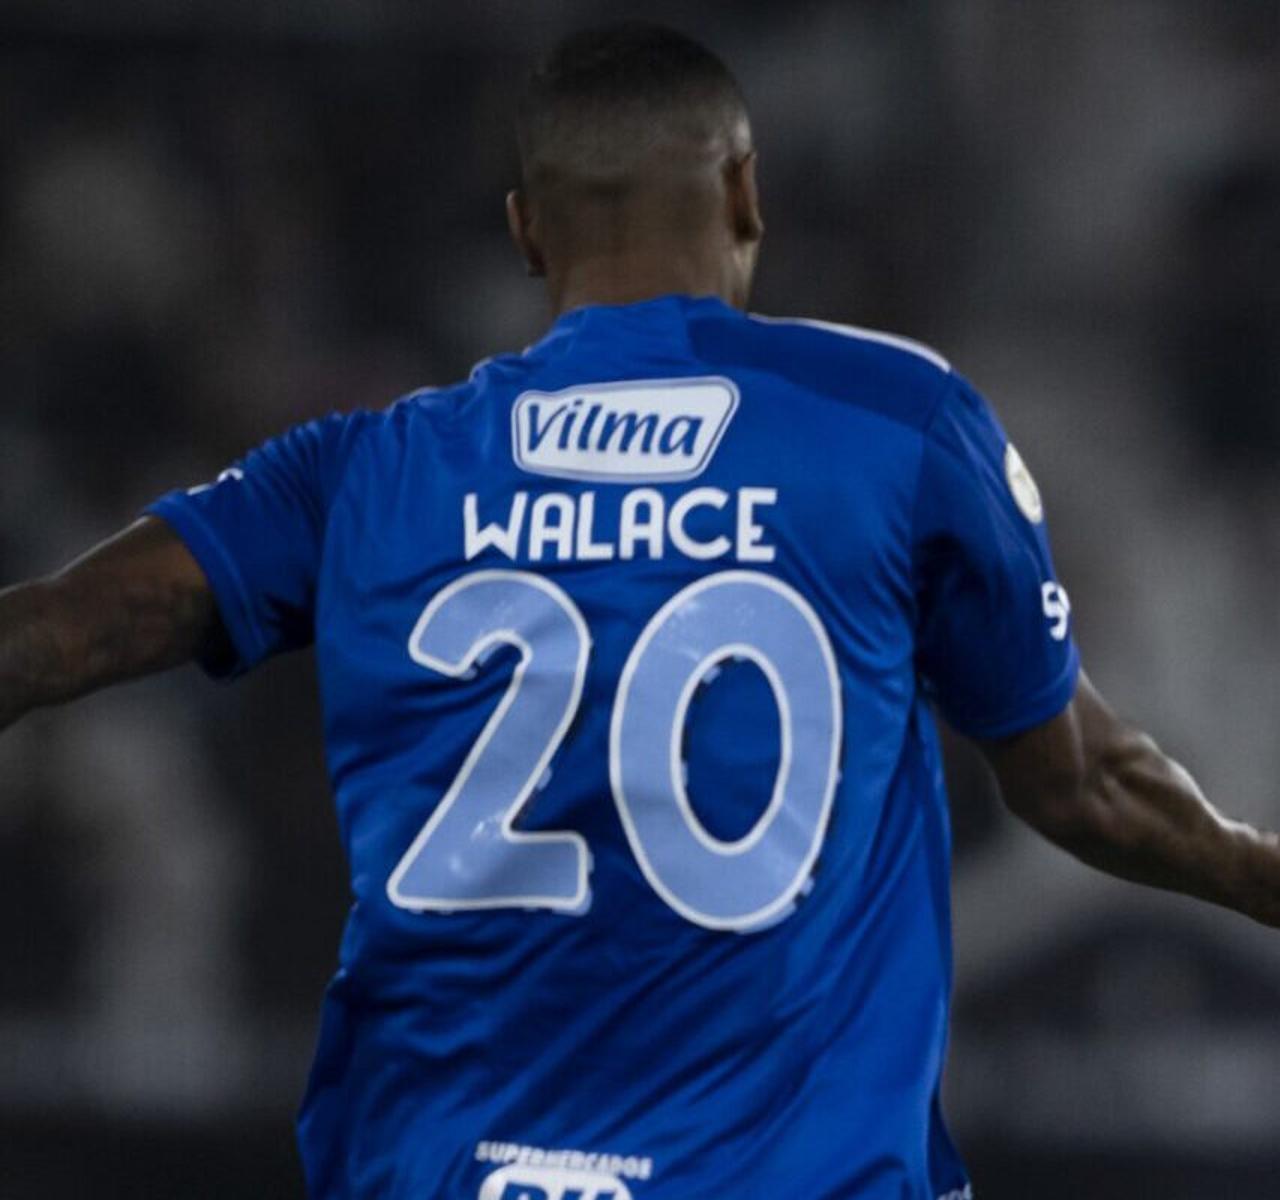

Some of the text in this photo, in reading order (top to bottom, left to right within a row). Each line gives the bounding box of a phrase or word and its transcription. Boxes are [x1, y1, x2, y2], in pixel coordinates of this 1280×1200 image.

[526, 399, 705, 457] Vilma
[463, 486, 779, 563] WALACE
[387, 569, 844, 933] 20
